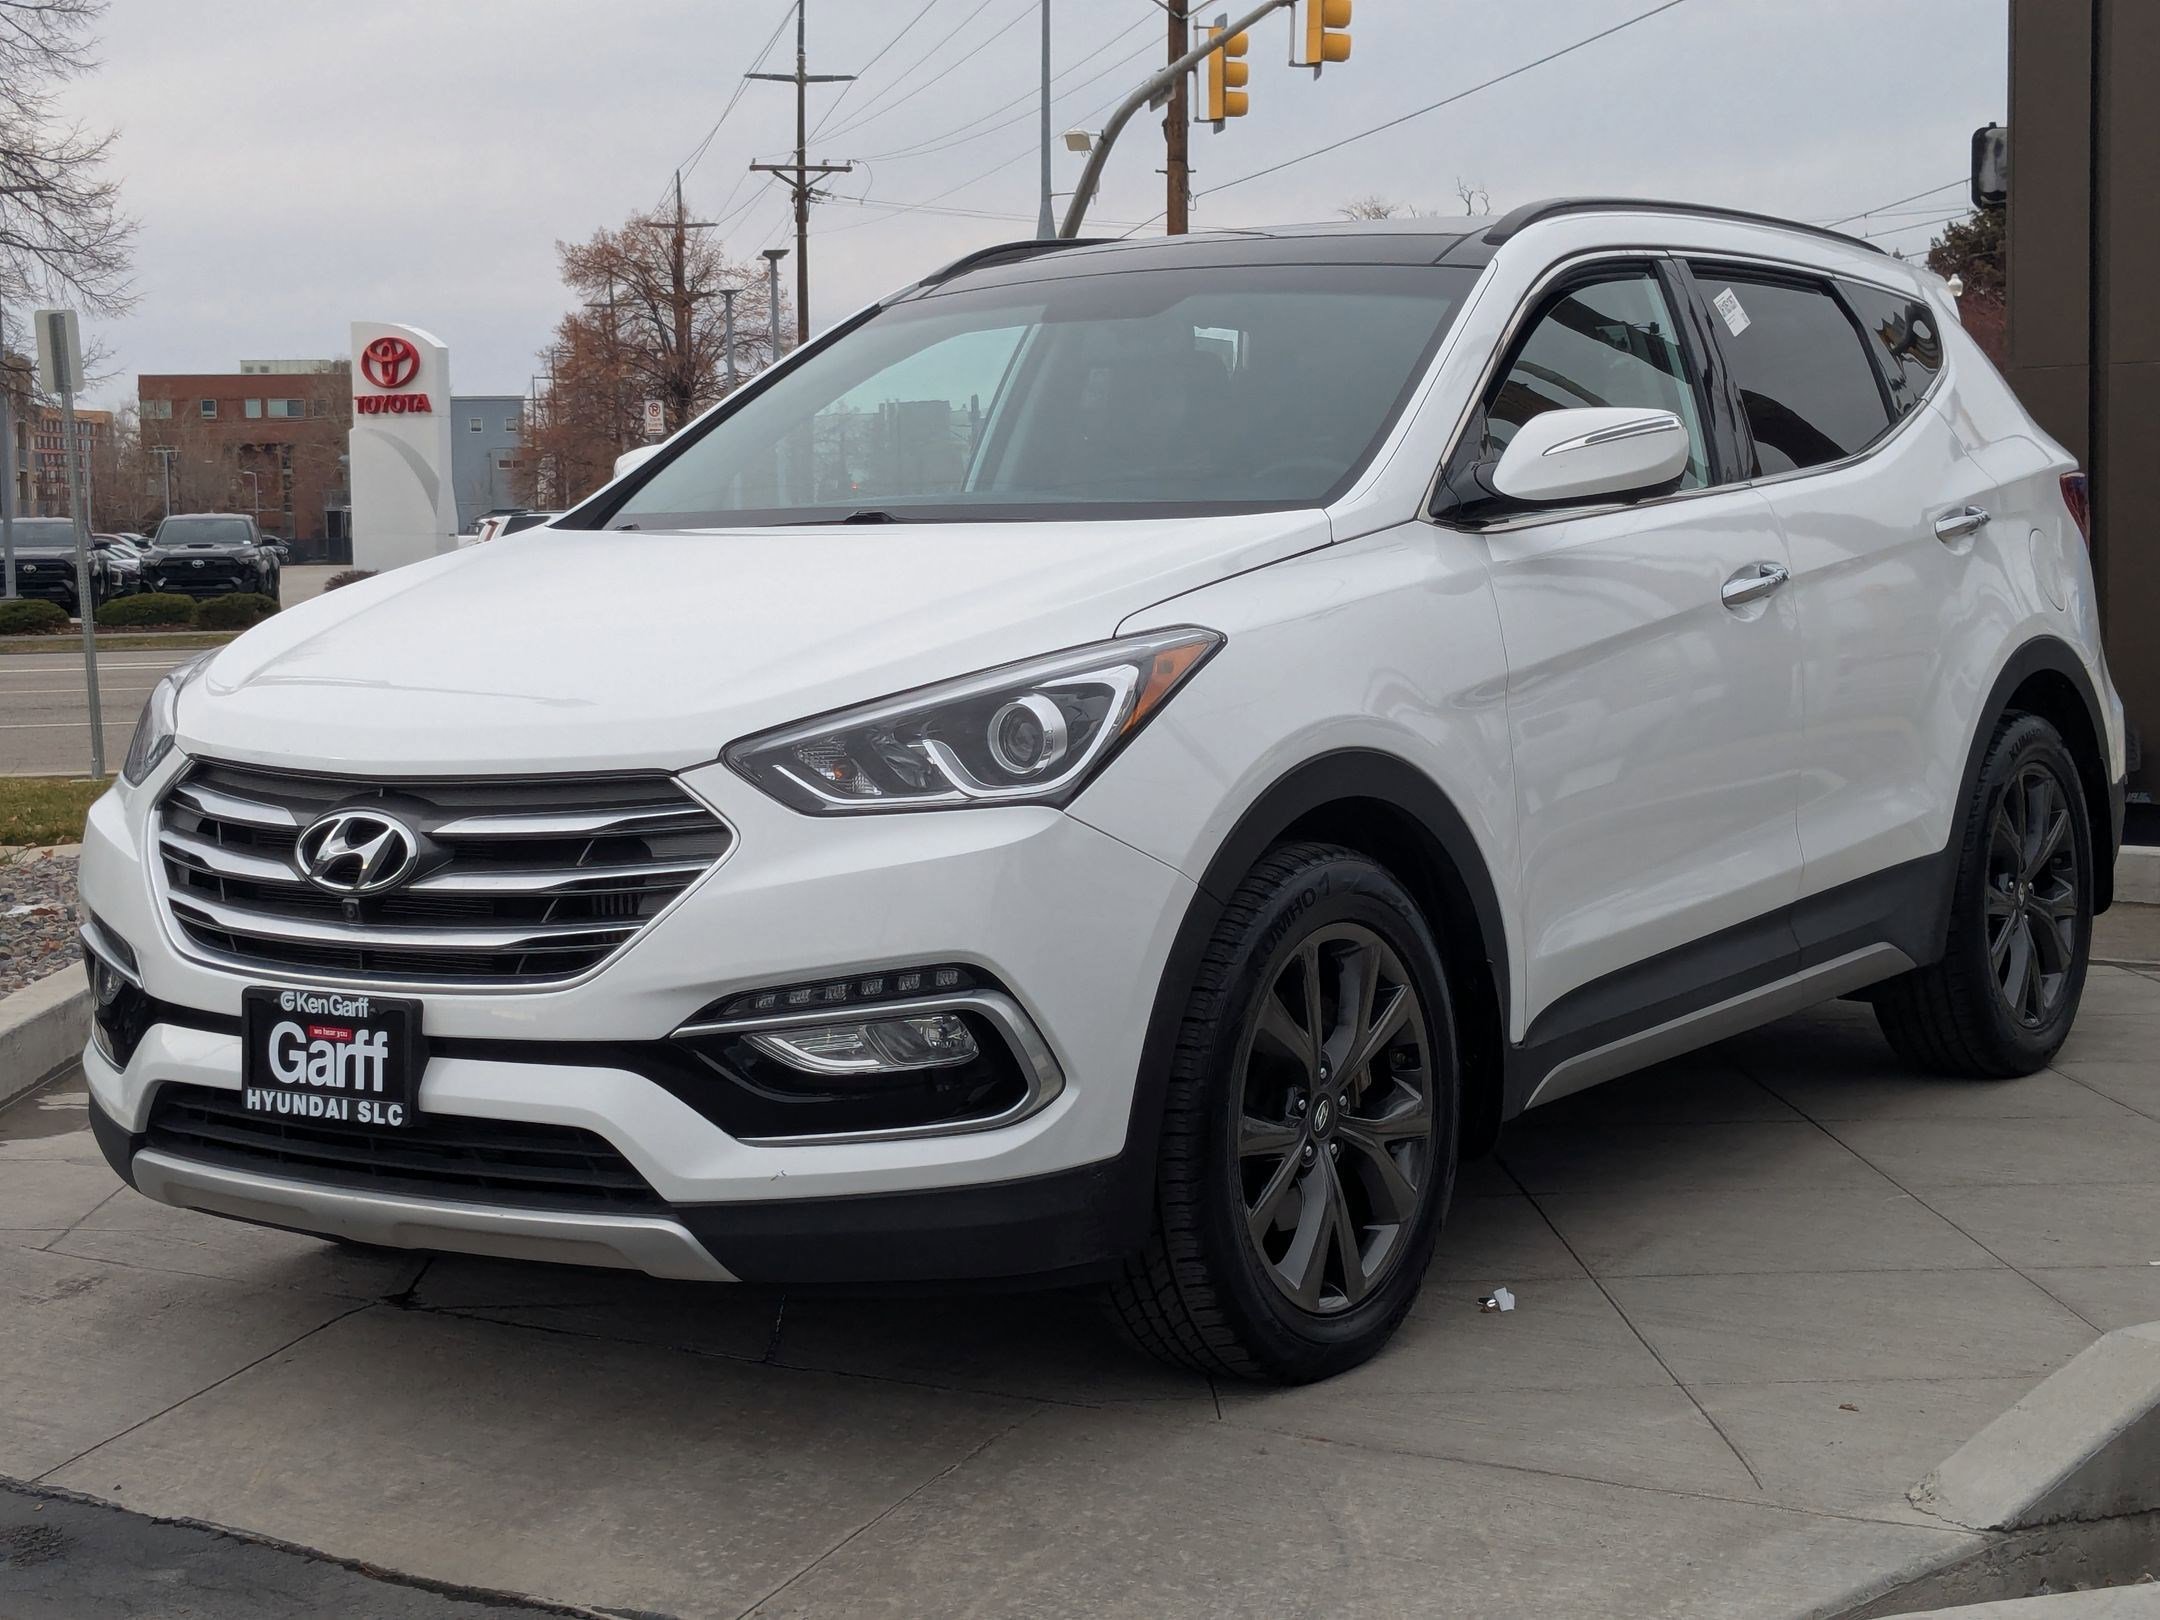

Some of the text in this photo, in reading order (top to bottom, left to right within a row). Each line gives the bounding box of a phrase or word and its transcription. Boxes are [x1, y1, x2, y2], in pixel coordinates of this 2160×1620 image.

[354, 394, 432, 414] TOYOTA
[269, 1021, 388, 1092] Garff
[247, 1089, 403, 1127] HYUNDAI SLC
